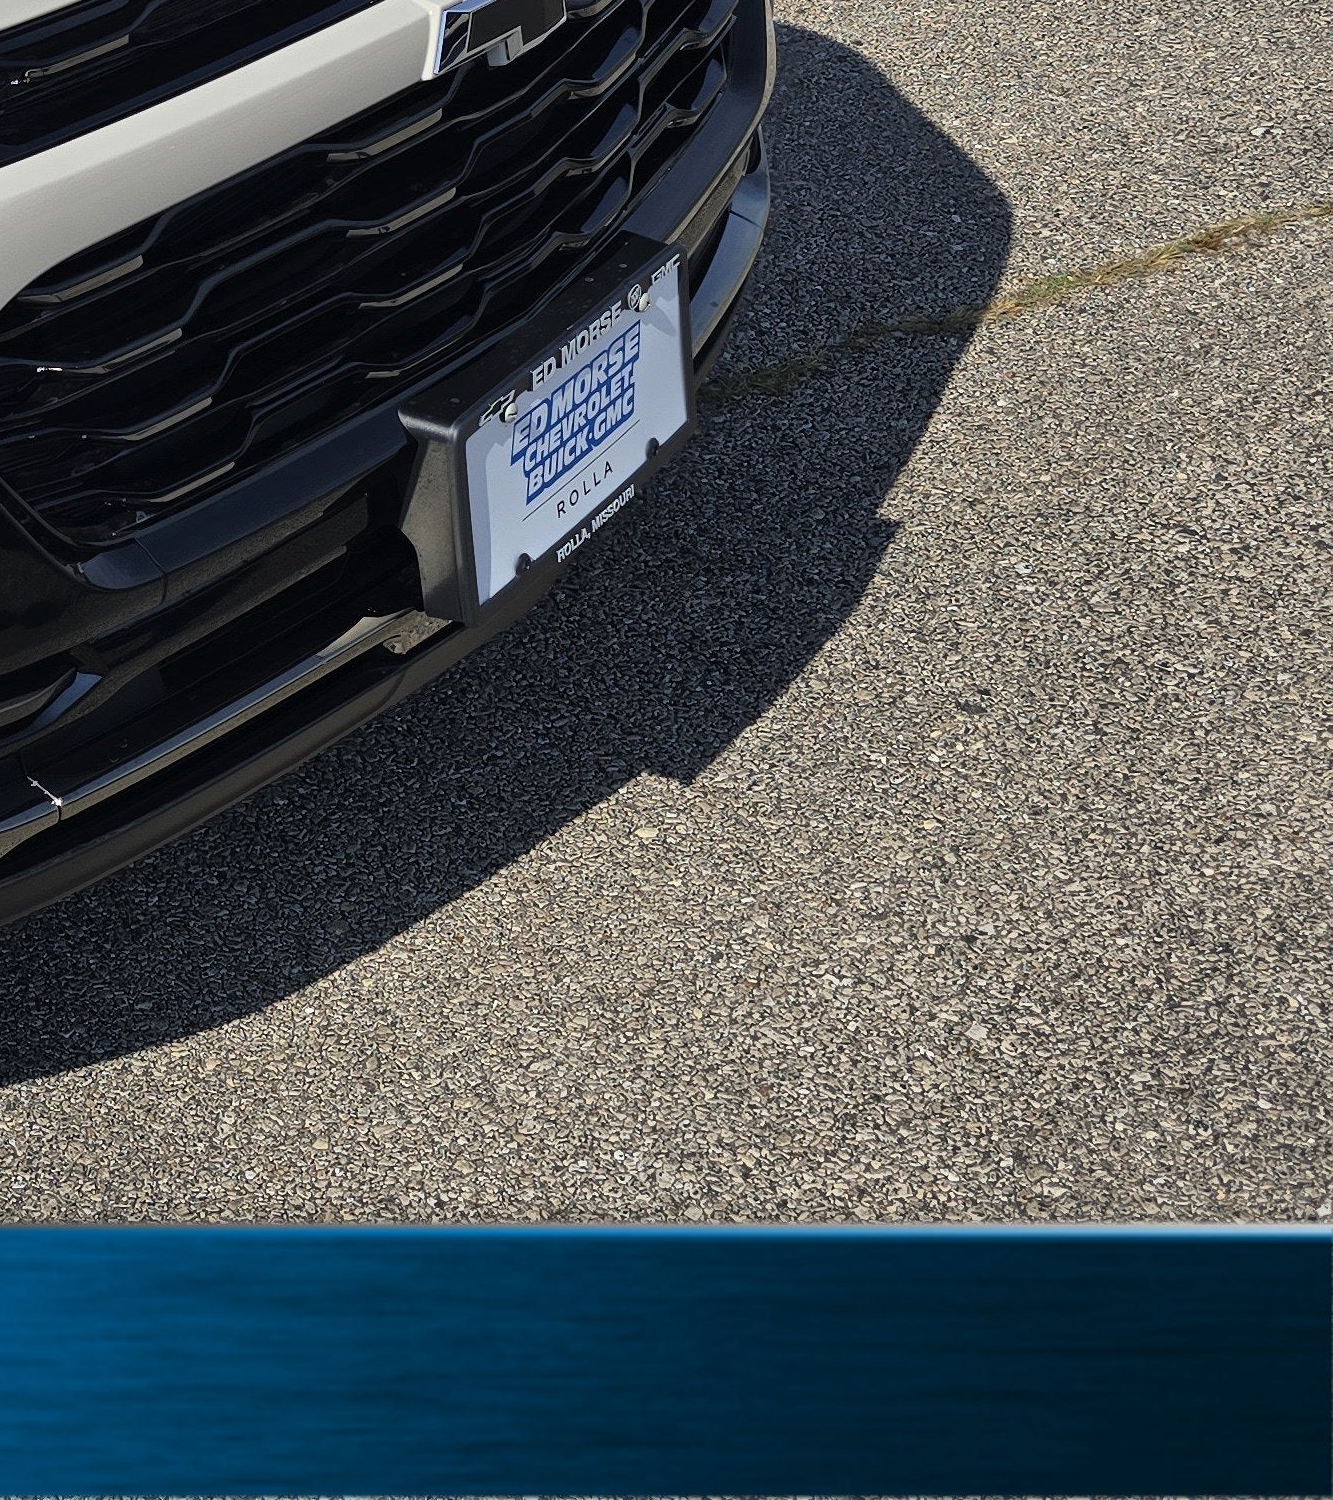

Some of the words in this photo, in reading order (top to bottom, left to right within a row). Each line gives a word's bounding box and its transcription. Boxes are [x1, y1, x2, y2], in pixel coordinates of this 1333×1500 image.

[512, 401, 550, 460] ED
[550, 321, 640, 427] MORSE
[531, 357, 557, 391] ED
[559, 300, 623, 368] MORSE
[523, 361, 635, 473] CHEVROLET
[555, 527, 591, 563] ROLLA,
[591, 483, 636, 533] MISSOURI
[556, 460, 613, 519] ROLLA
